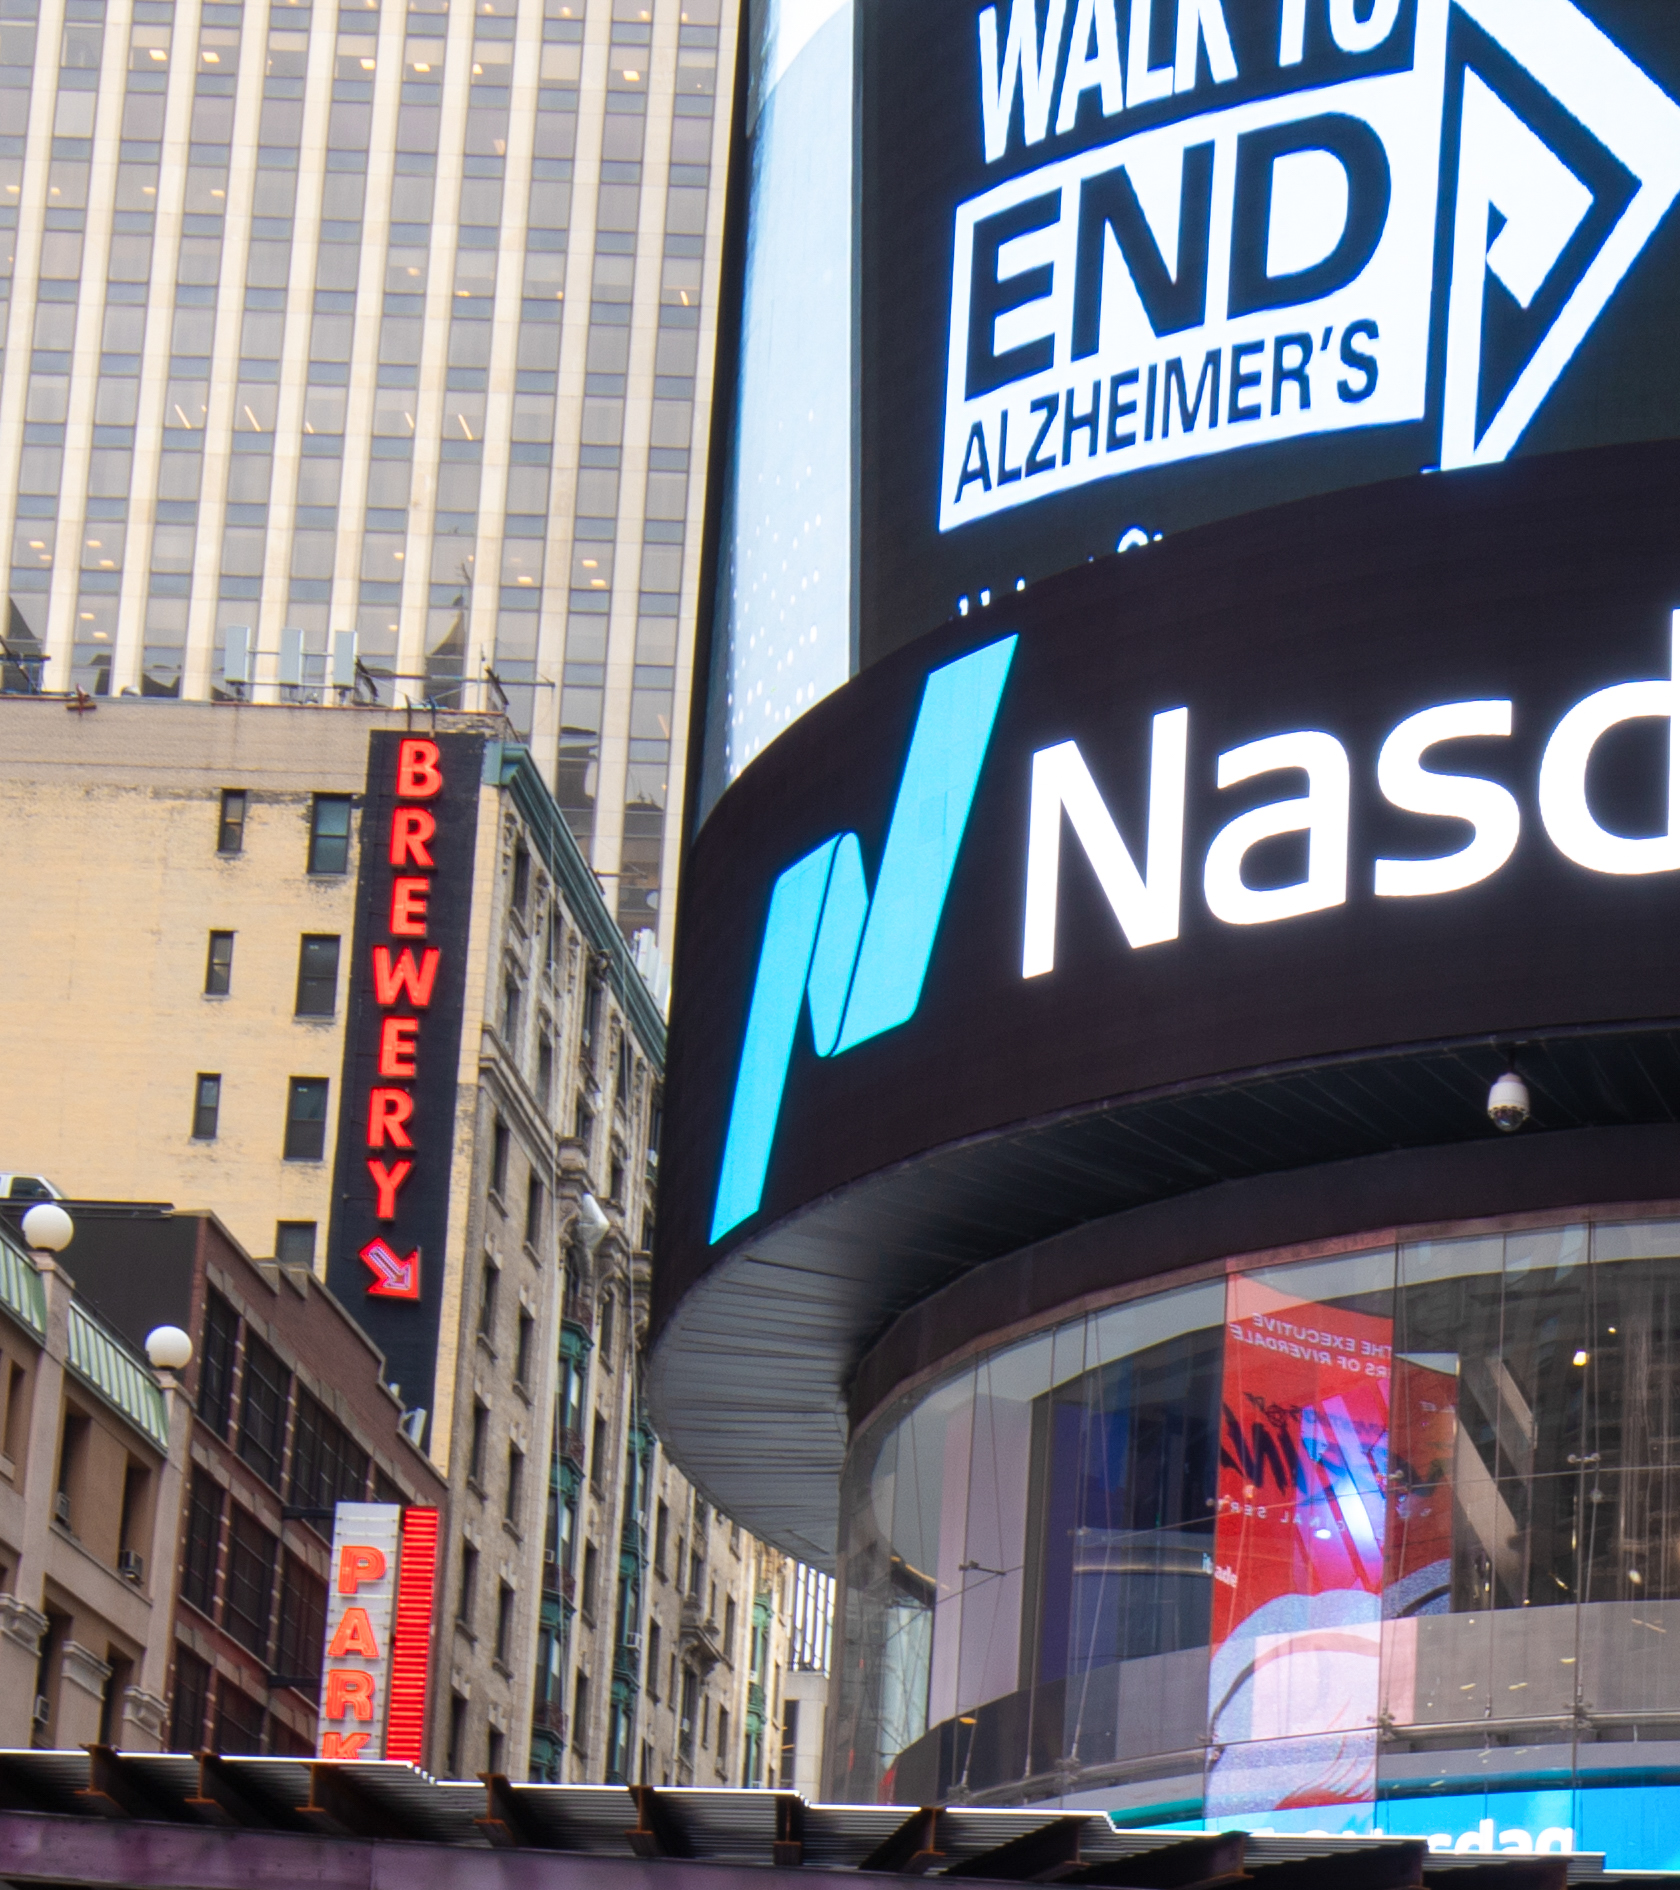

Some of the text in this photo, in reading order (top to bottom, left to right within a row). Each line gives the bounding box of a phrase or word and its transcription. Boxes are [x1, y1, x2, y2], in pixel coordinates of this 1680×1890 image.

[978, 0, 1239, 165] WALK
[966, 107, 1396, 385] END
[951, 315, 1383, 497] ALZHEIMER'S
[366, 738, 442, 1220] BREWERY
